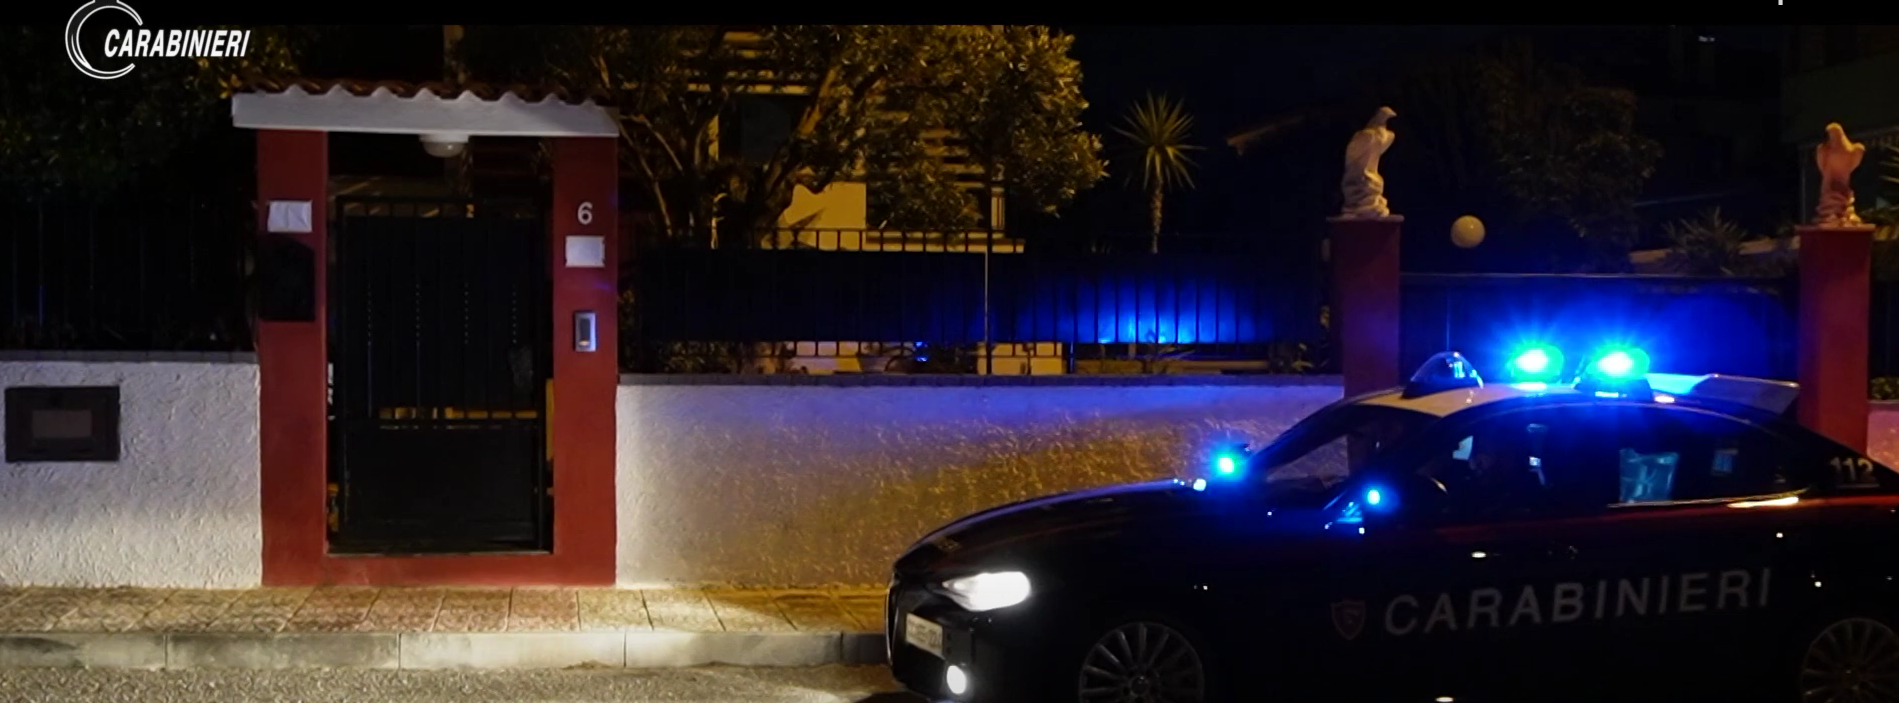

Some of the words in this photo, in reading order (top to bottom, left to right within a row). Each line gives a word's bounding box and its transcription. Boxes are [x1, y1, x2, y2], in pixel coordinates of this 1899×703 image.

[577, 202, 593, 225] 6
[1829, 456, 1876, 483] 112
[1384, 567, 1772, 636] CARABINIERI
